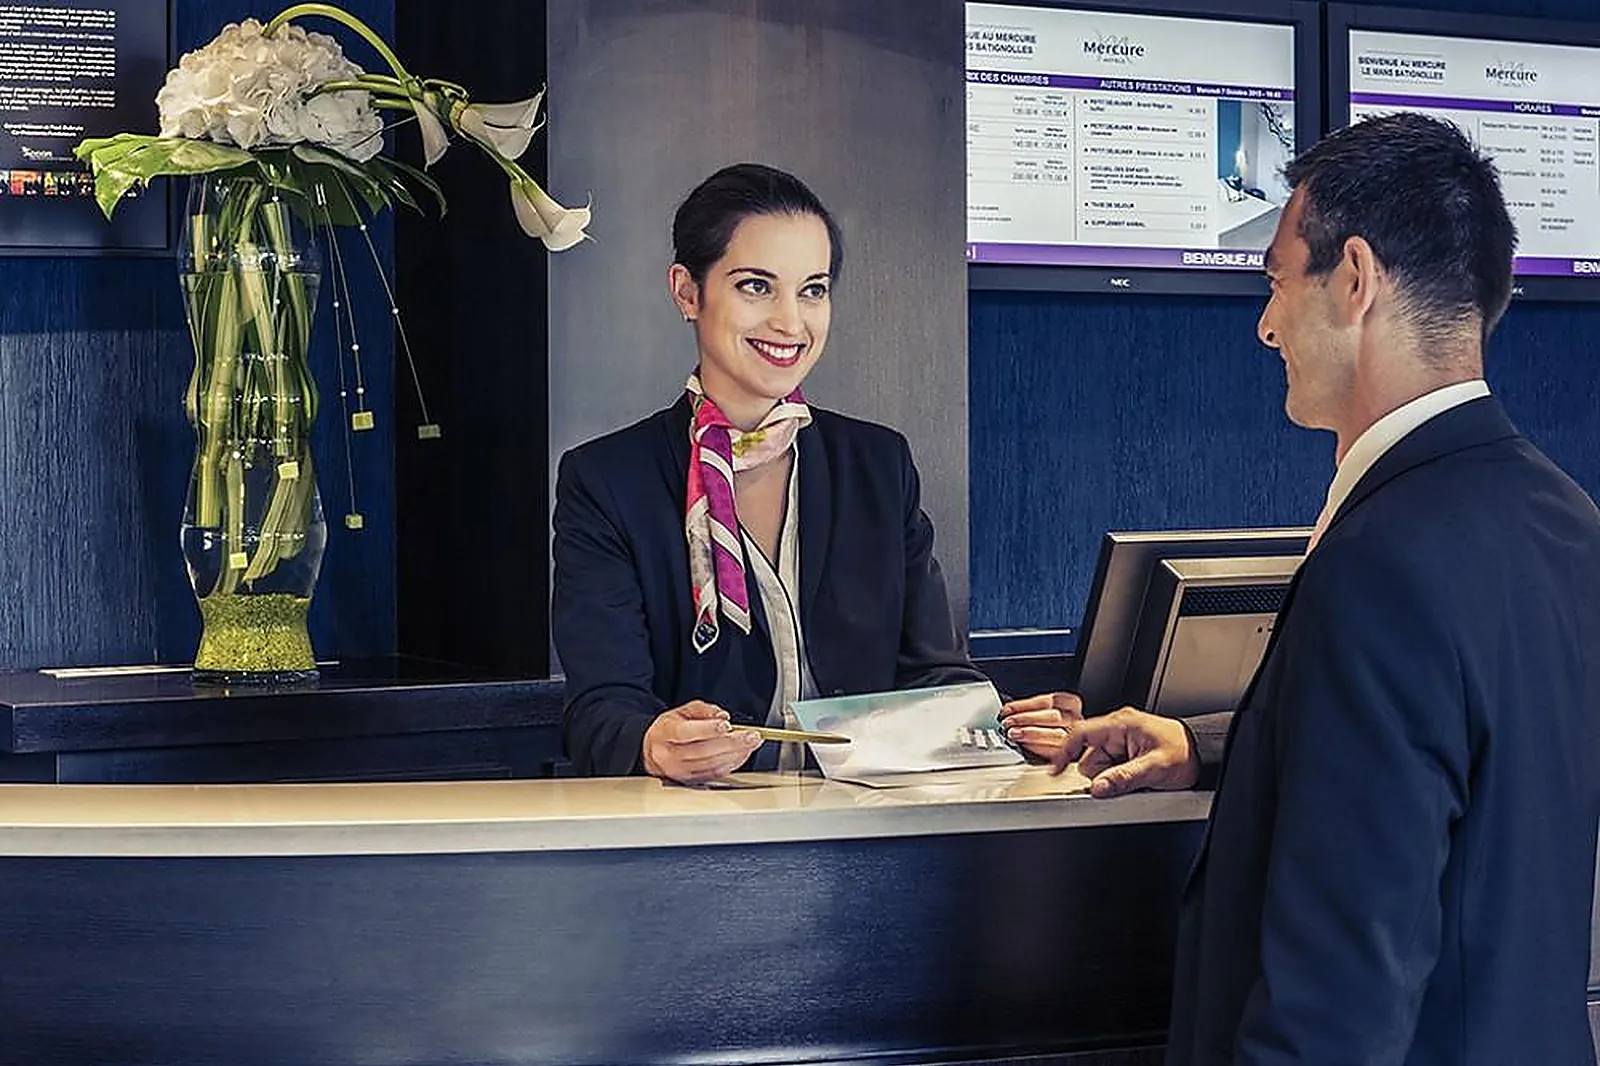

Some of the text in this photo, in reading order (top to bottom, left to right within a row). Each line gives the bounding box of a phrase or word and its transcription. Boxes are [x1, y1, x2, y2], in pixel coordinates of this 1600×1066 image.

[982, 31, 994, 41] AU
[995, 32, 1036, 43] MERCURE
[976, 42, 1033, 54] BATIGNOLLES
[1083, 41, 1145, 57] Mercure
[1358, 56, 1446, 70] BIENVENUE AU MERCURE
[980, 72, 1000, 82] DES
[1000, 73, 1049, 86] CHAMBRES
[1361, 67, 1444, 80] LE MANS BATIGNOLLES
[1485, 67, 1538, 82] Mercure
[1100, 79, 1192, 93] AUTRES PRESTATIONS
[1514, 103, 1552, 113] HORAIRES
[1183, 252, 1264, 266] BIENVENUE AU
[1111, 278, 1130, 287] NEC
